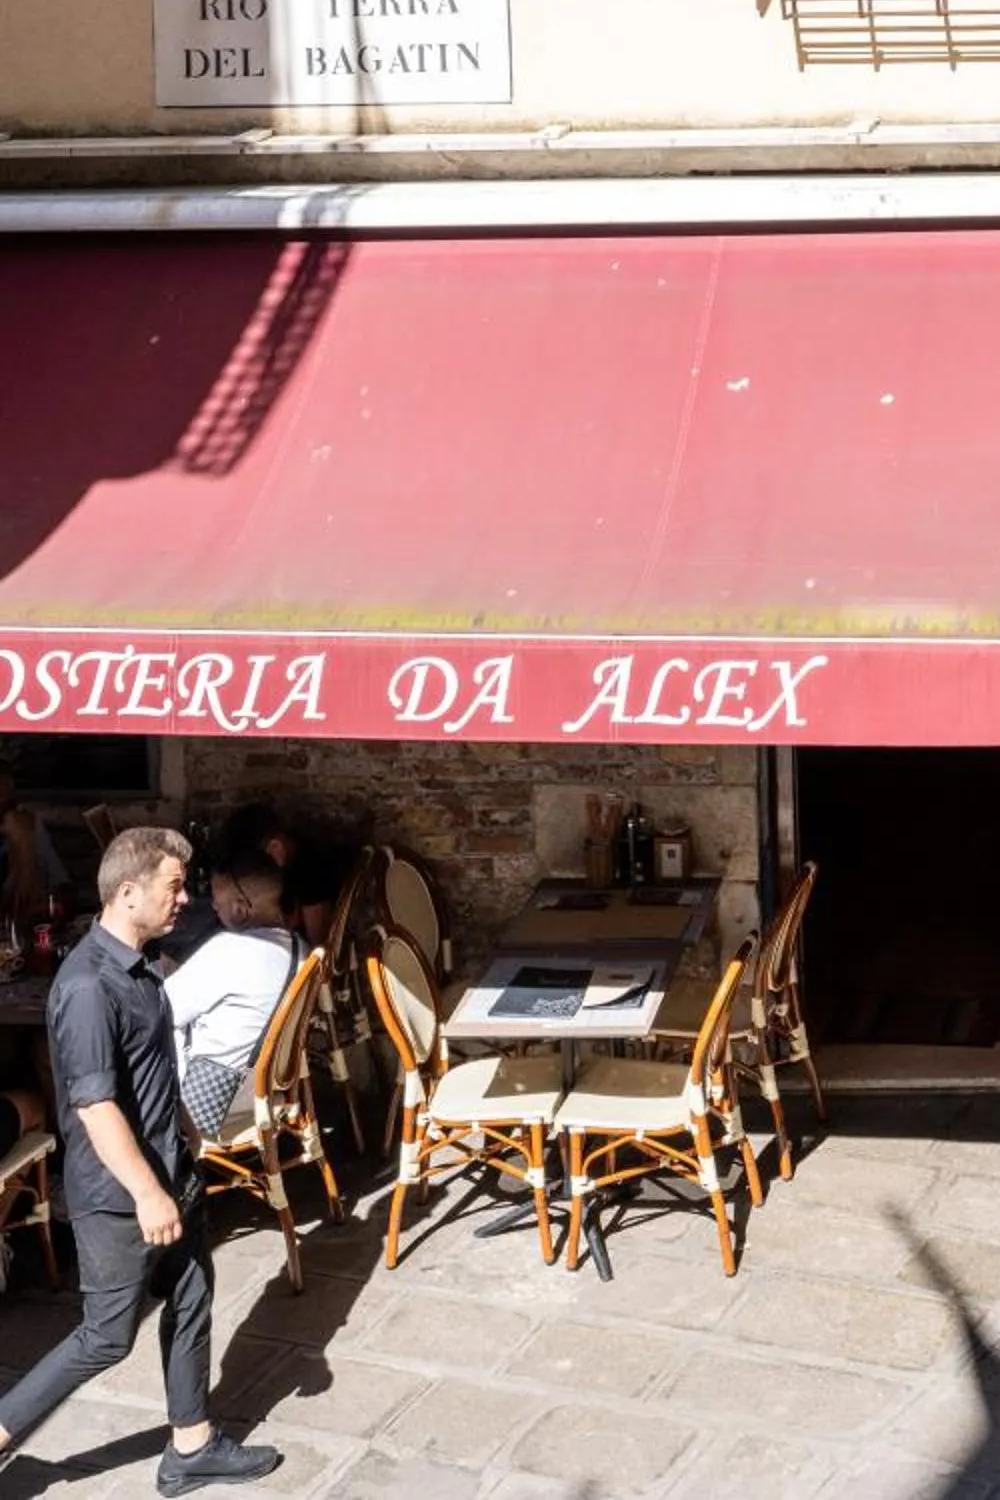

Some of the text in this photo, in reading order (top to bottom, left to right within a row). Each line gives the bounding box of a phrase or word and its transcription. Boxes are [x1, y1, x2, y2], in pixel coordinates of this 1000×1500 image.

[184, 42, 481, 79] DEL BAGATIN
[388, 655, 514, 733] DA
[562, 654, 829, 733] ALEX
